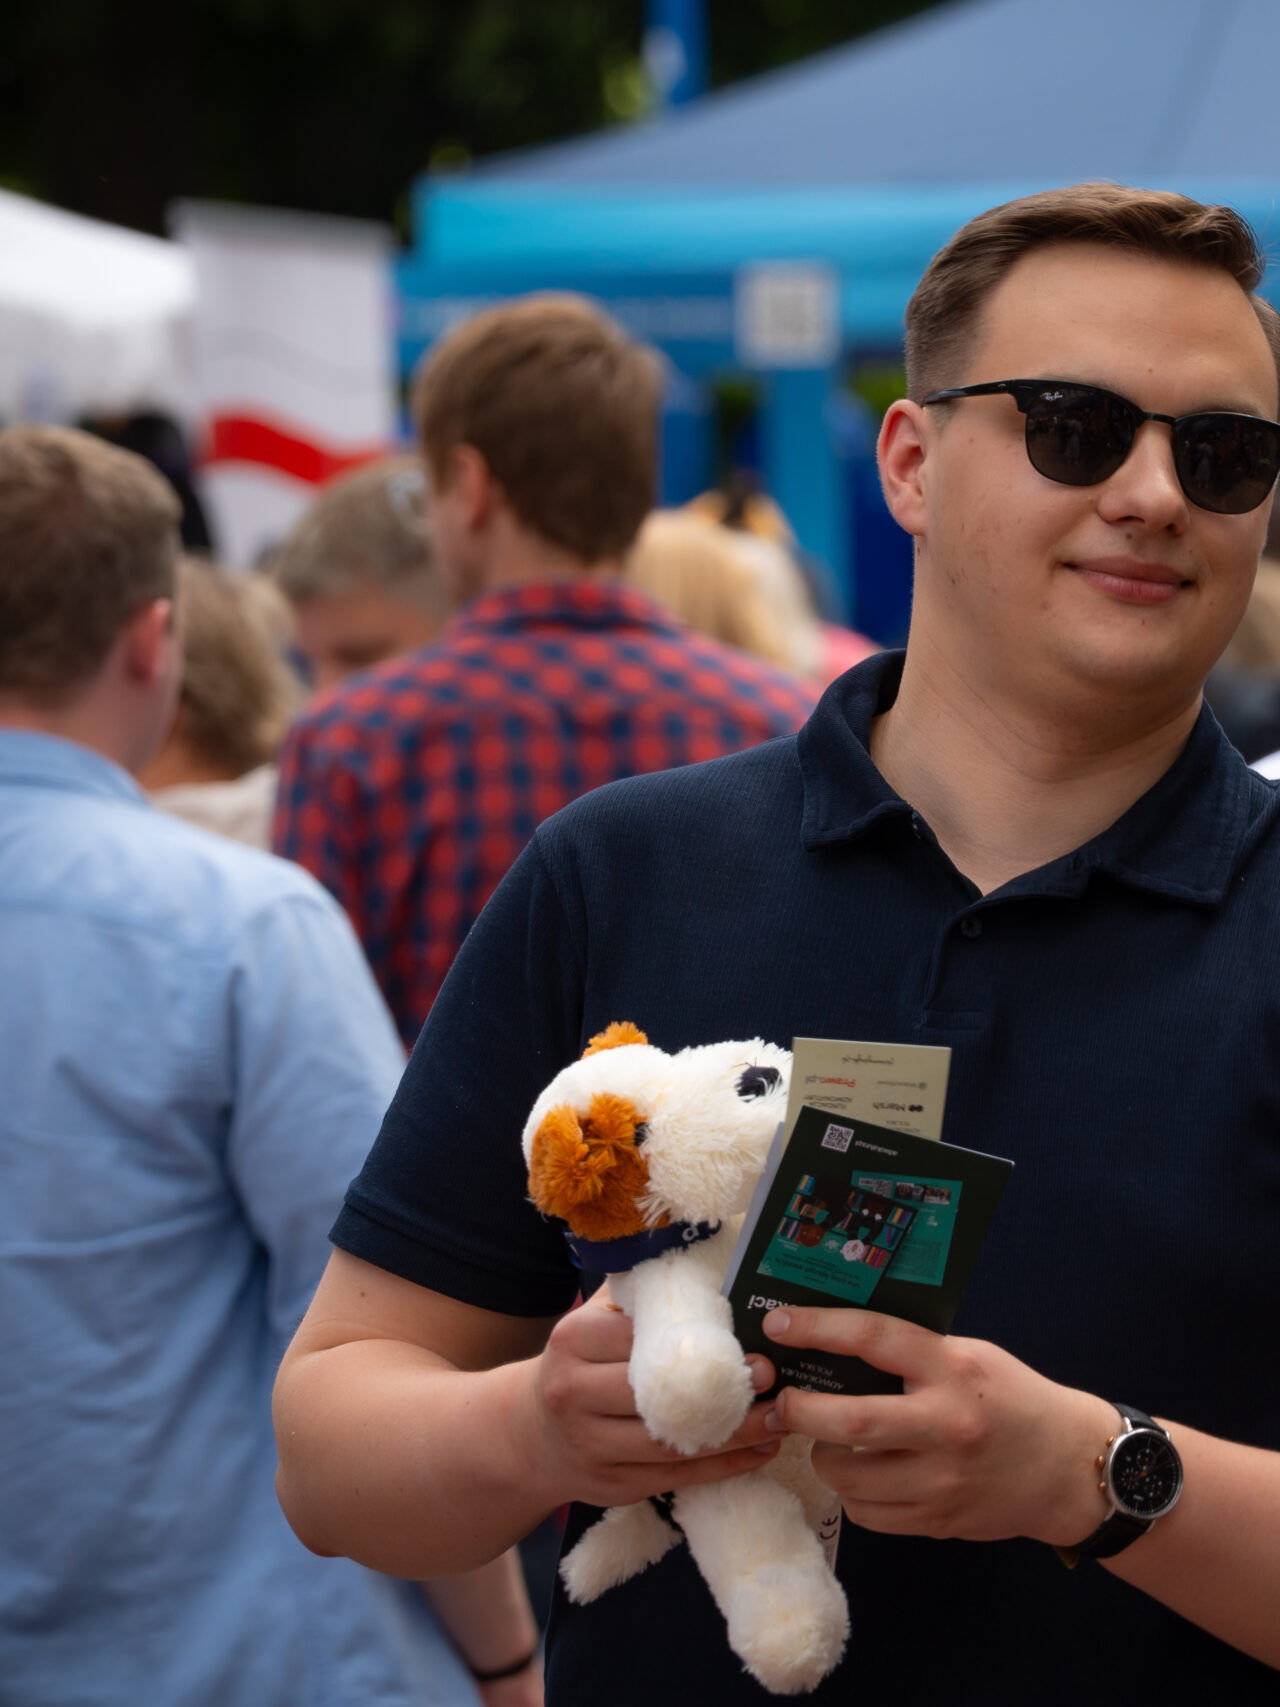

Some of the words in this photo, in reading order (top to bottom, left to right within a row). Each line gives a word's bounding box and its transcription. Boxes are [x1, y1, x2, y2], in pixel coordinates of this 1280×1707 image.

[872, 1102, 906, 1112] Marsh
[800, 1360, 833, 1376] POLSKA
[781, 1367, 846, 1391] ADWOKATURA
